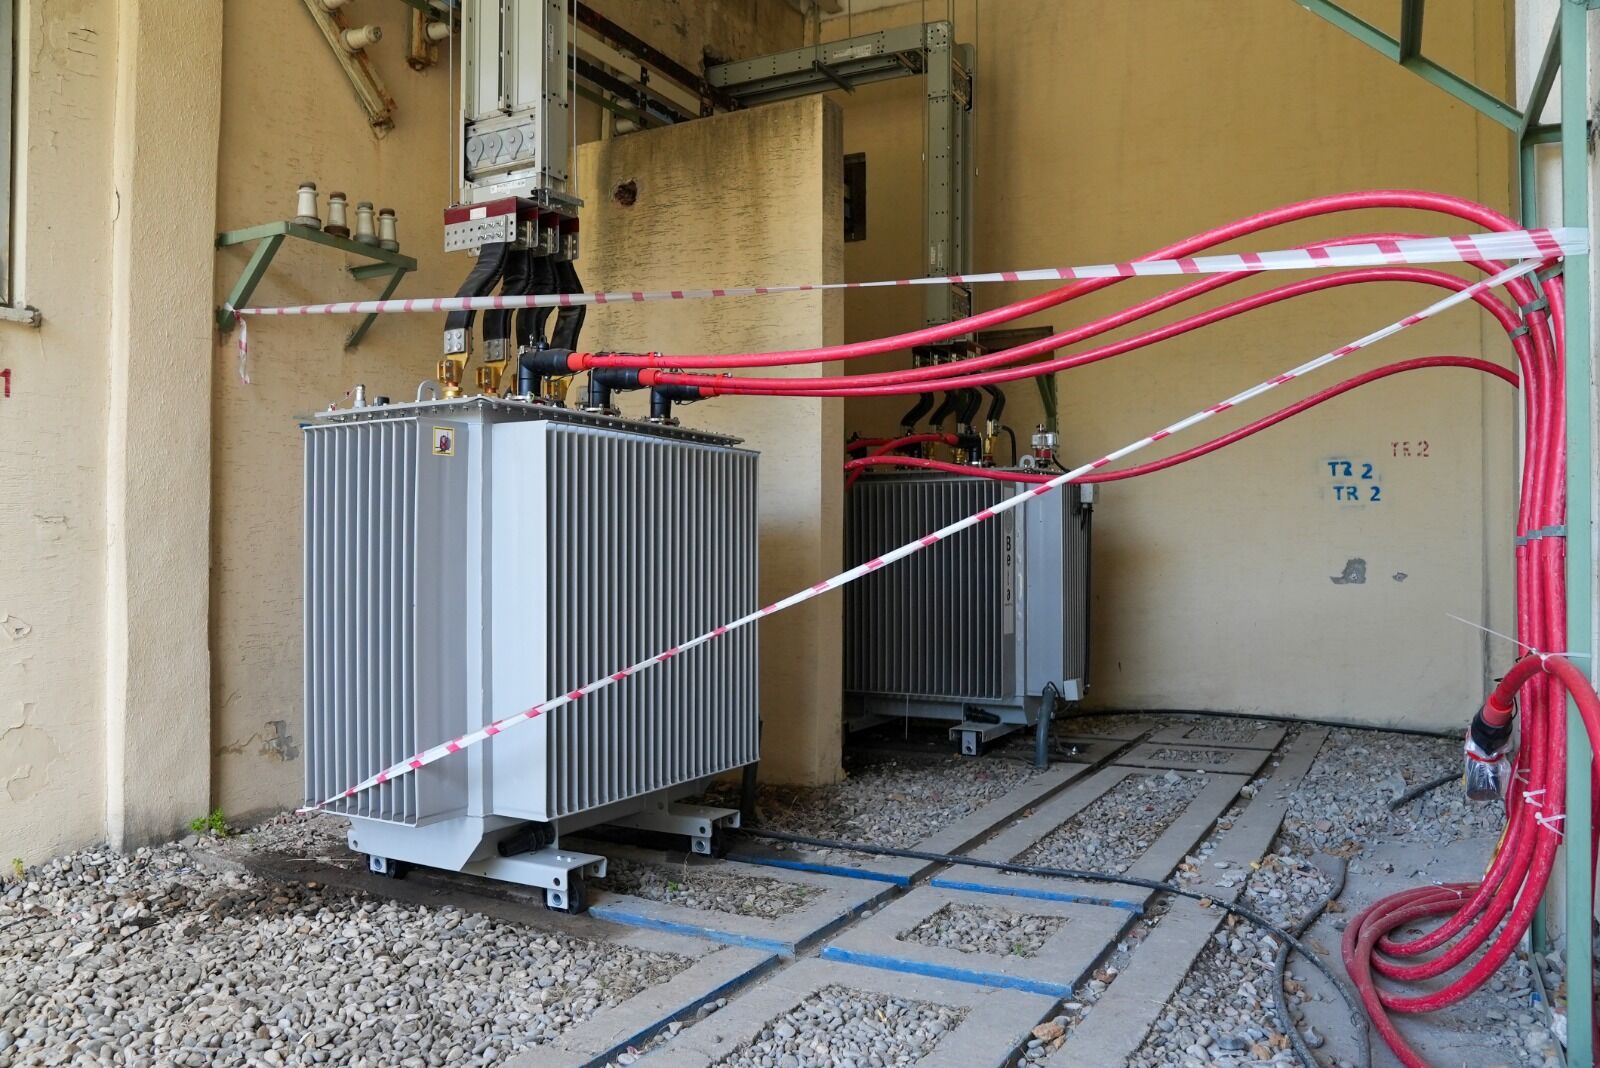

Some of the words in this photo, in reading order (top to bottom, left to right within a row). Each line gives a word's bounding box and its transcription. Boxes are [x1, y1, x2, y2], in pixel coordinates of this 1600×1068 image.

[1391, 441, 1411, 457] TR
[1417, 440, 1430, 457] 2
[1361, 463, 1373, 479] 2
[1333, 485, 1359, 501] TR
[1370, 486, 1381, 502] 2
